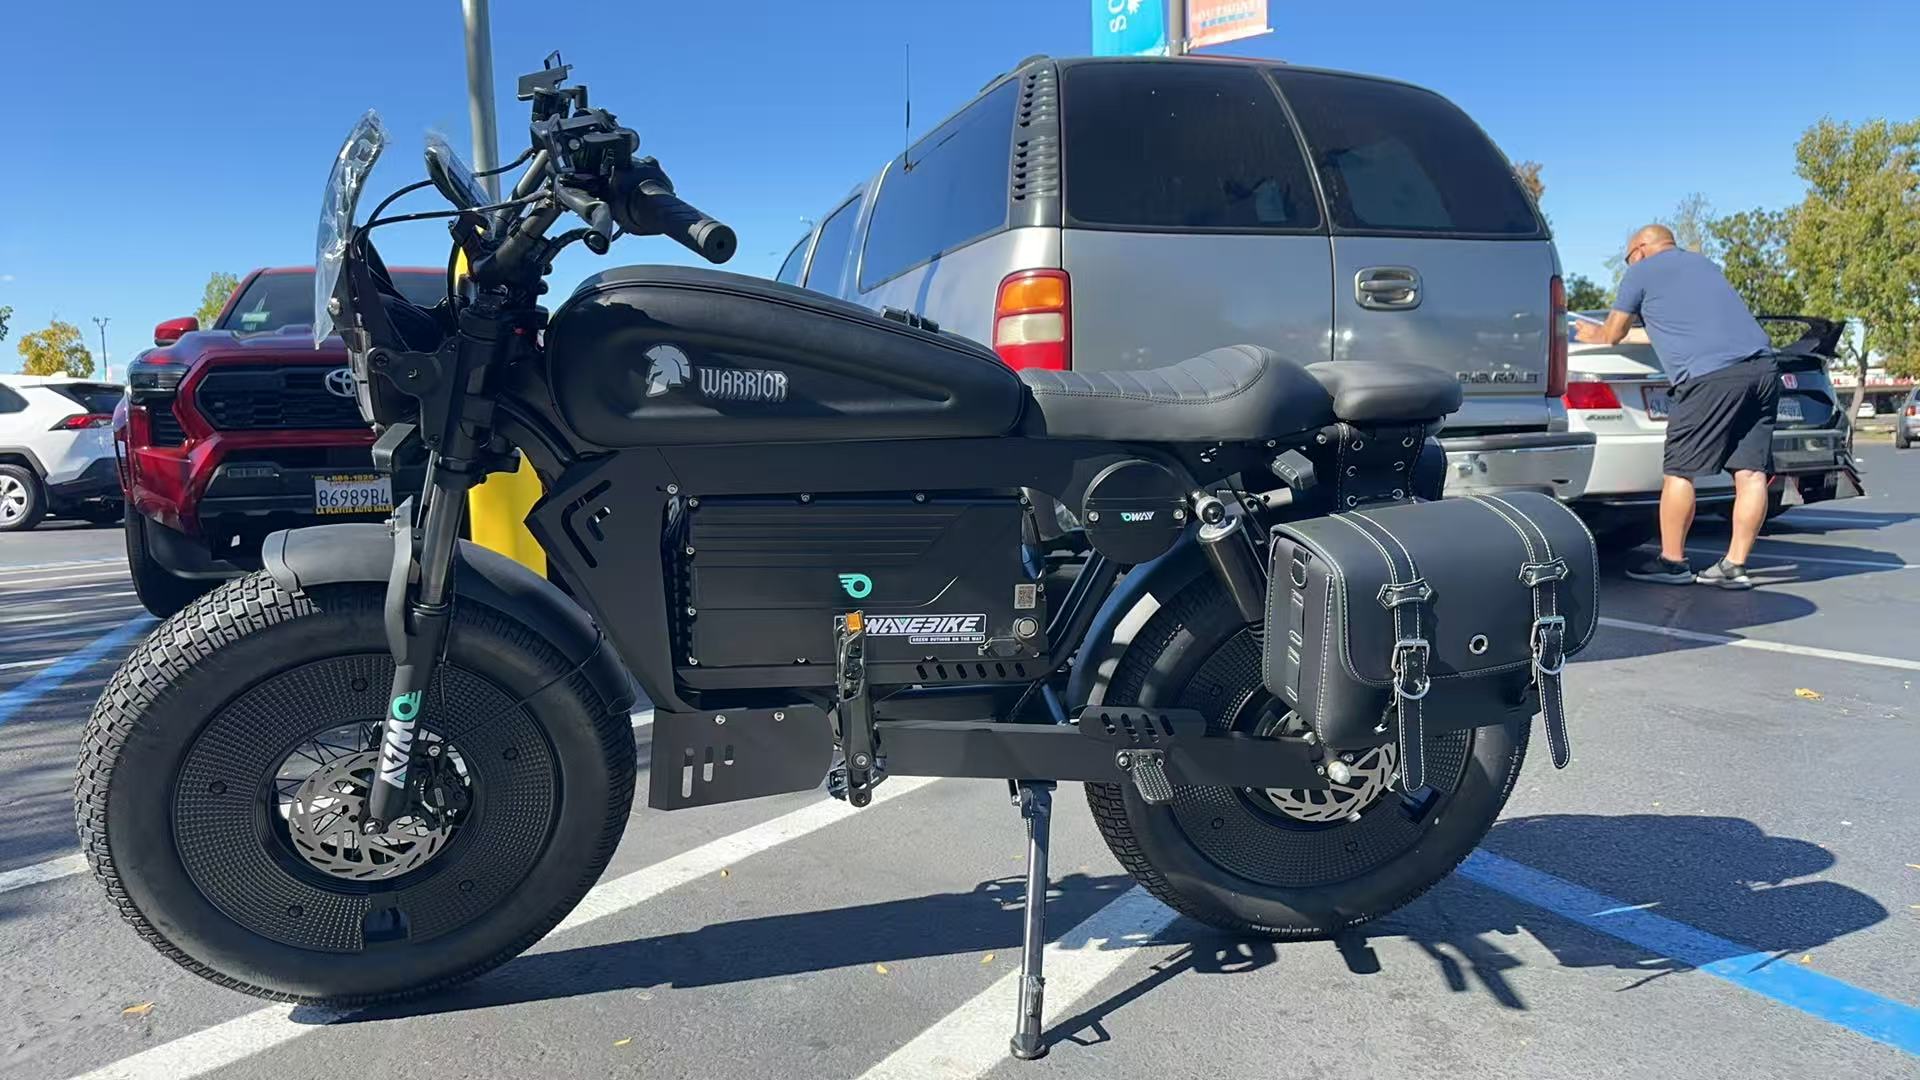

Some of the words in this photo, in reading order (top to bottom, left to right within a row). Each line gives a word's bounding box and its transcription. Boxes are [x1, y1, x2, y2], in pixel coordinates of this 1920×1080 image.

[700, 368, 788, 400] WARRIOR
[1456, 370, 1541, 384] CHEVROLET
[319, 488, 389, 507] 86989B4
[355, 505, 372, 513] AUTO
